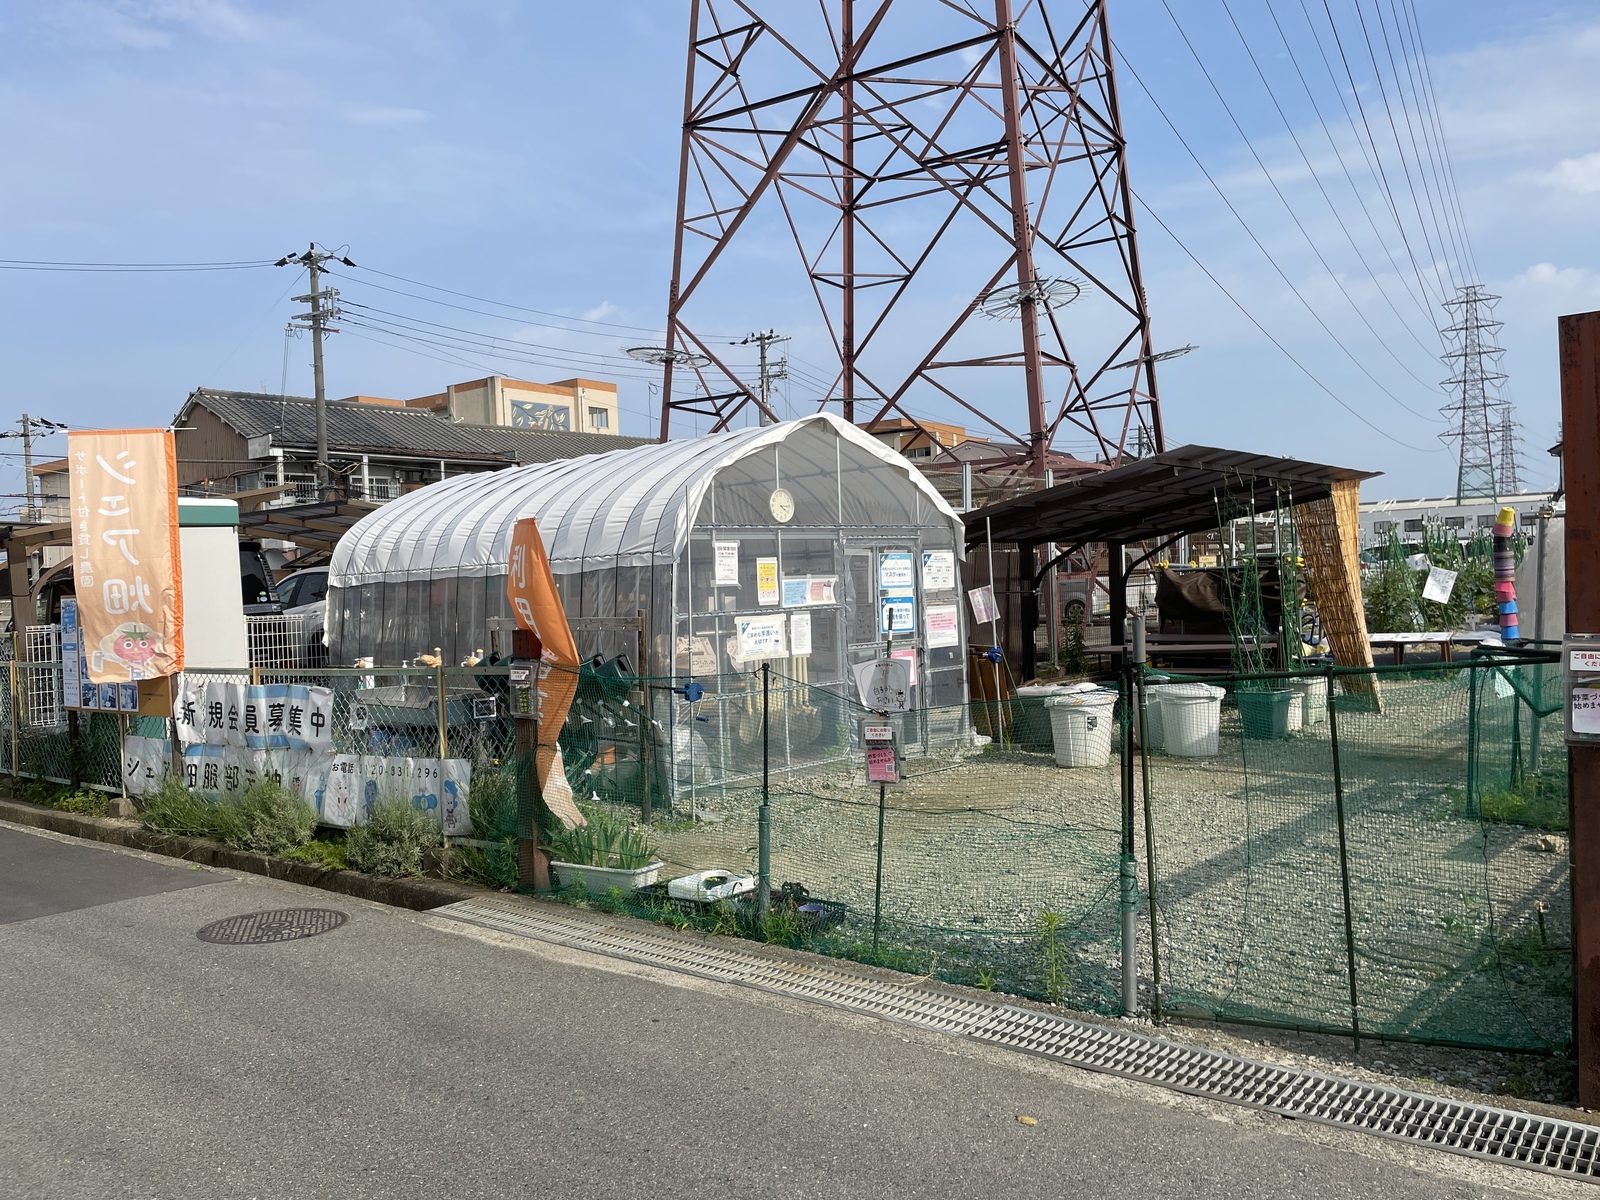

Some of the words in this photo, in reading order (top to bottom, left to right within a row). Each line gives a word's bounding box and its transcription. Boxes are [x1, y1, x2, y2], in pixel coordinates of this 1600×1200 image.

[1573, 693, 1600, 701] 野菜づ
[176, 700, 326, 737] 新規会員募集中
[332, 762, 355, 774] お電話
